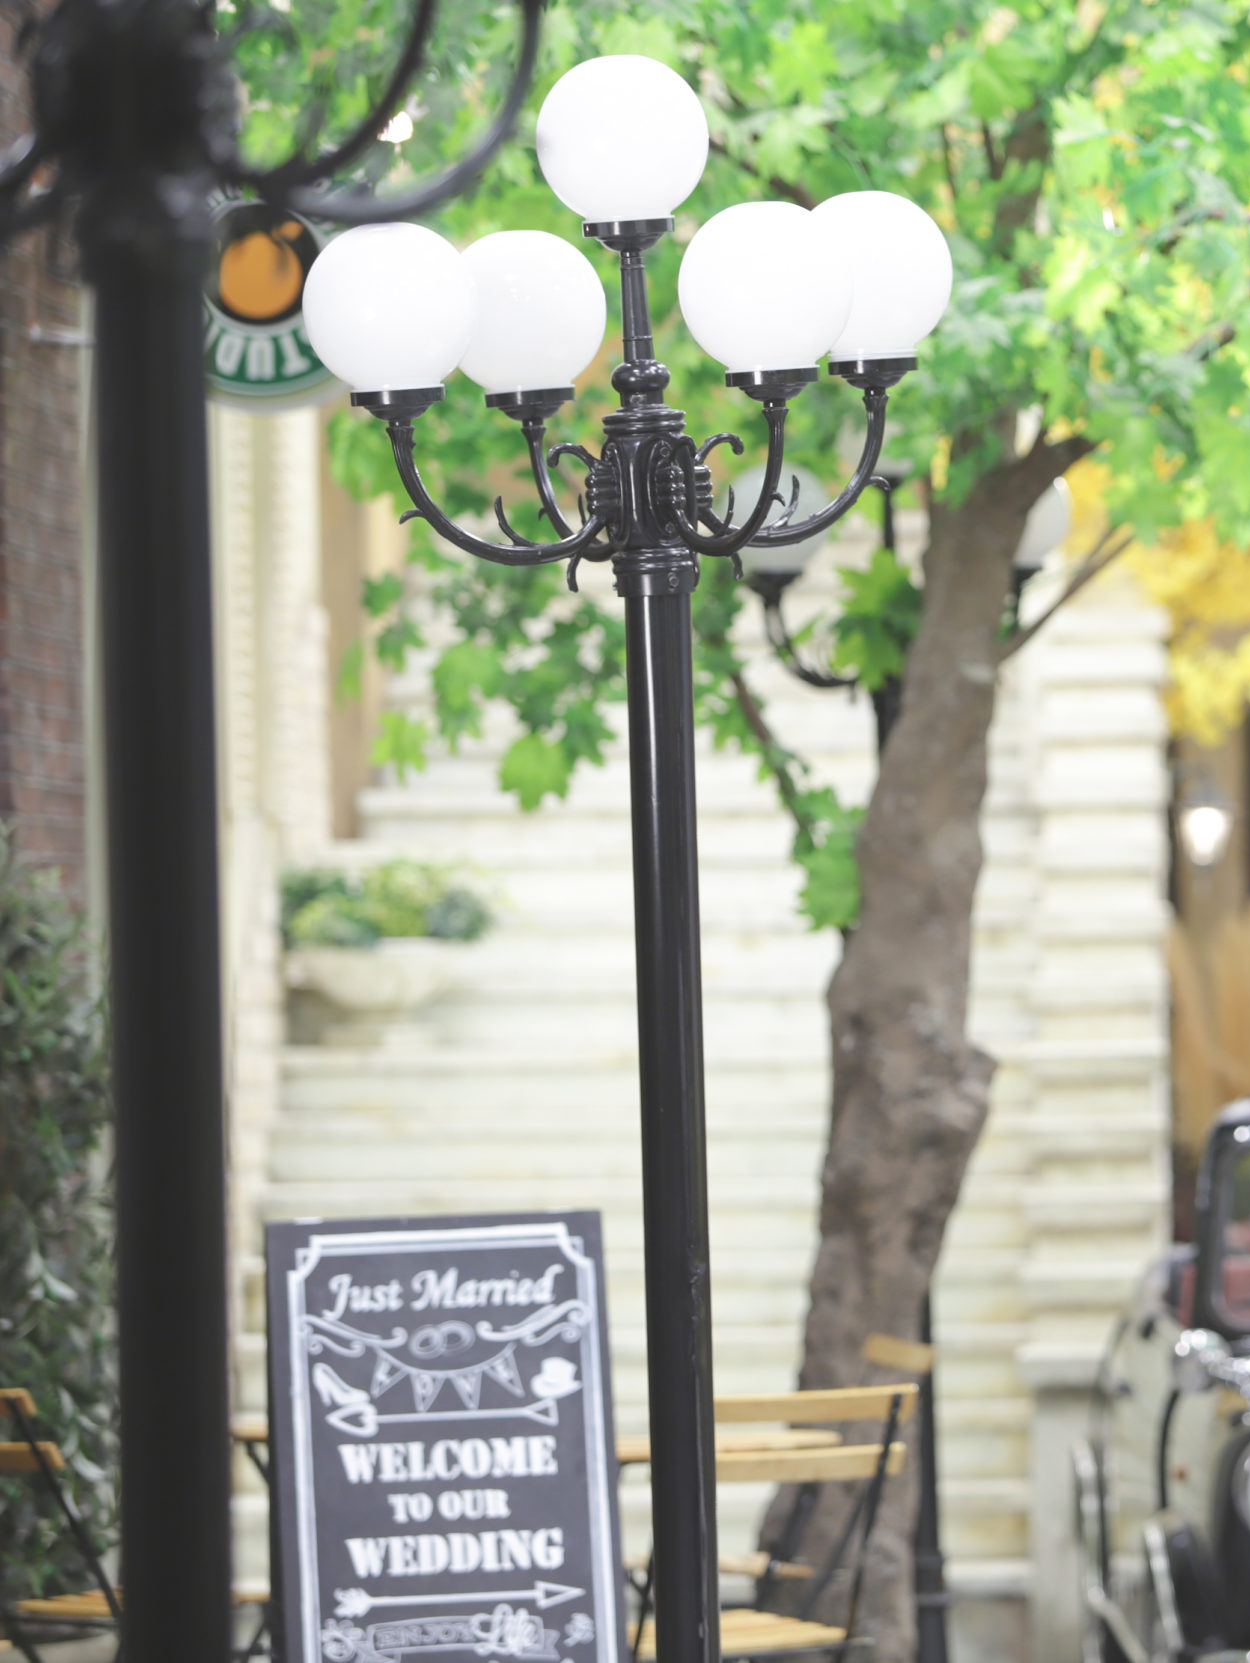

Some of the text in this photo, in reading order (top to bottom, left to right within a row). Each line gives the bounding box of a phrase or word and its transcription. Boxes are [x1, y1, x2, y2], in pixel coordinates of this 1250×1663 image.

[322, 1264, 564, 1321] Just Married
[337, 1435, 559, 1484] WELCOME
[387, 1488, 512, 1524] TO OUR
[344, 1527, 565, 1579] WEDDING
